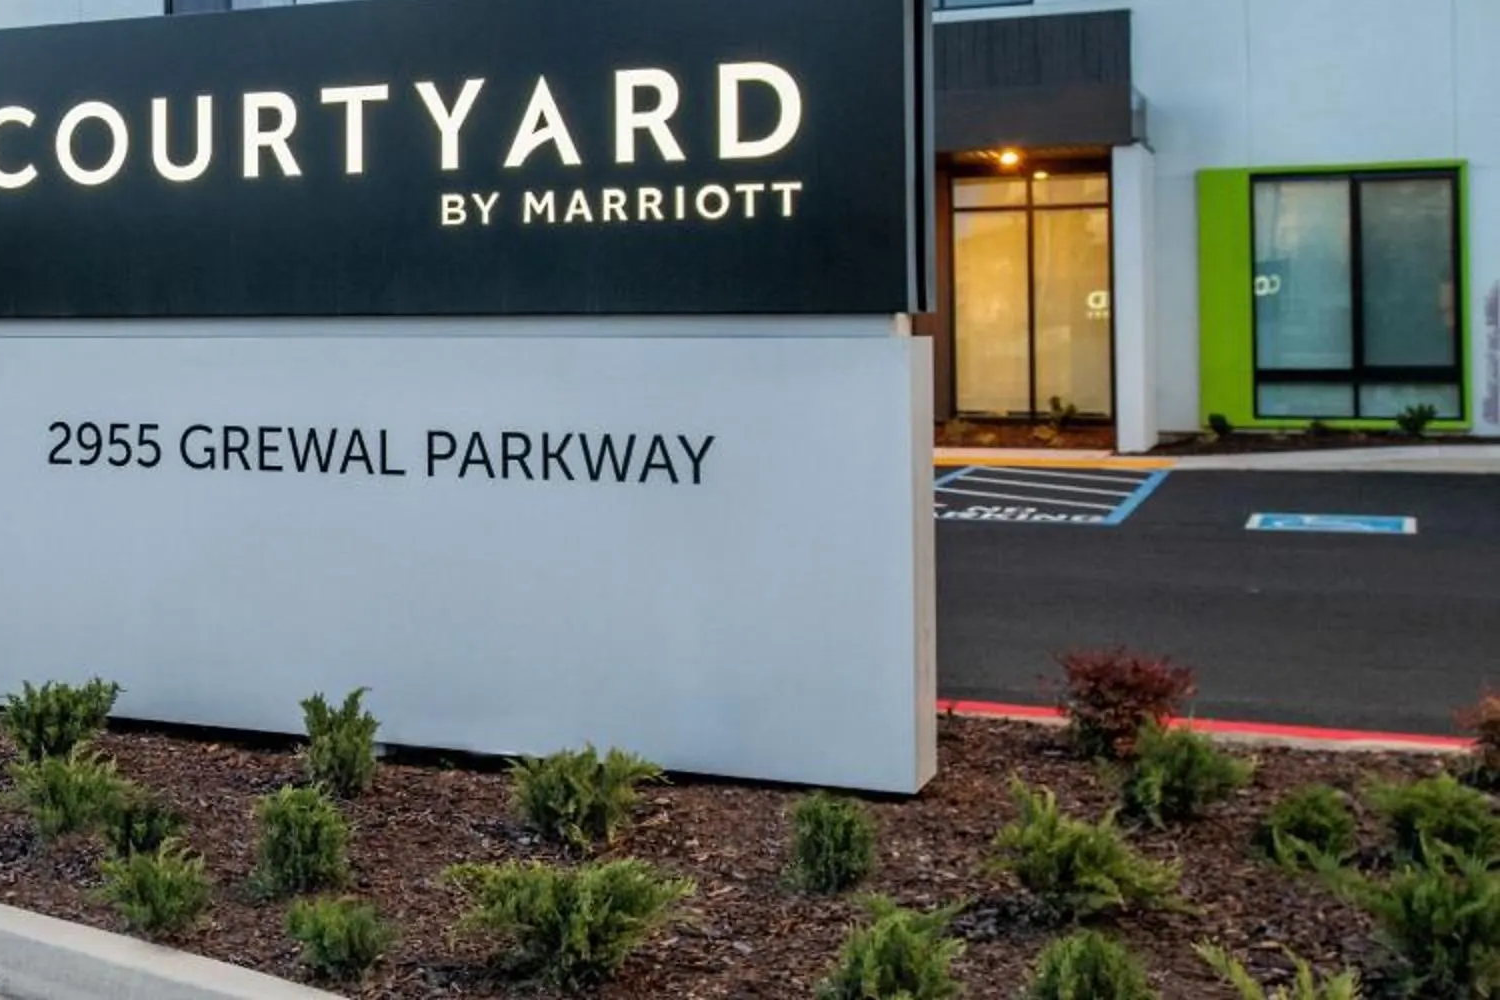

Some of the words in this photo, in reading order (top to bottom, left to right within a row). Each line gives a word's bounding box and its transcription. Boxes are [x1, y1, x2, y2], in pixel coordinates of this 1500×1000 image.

[441, 191, 500, 226] BY
[523, 181, 803, 224] MARRIOTT
[47, 421, 162, 469] 2955
[179, 423, 407, 477] GREWAL
[427, 430, 716, 485] PARKWAY
